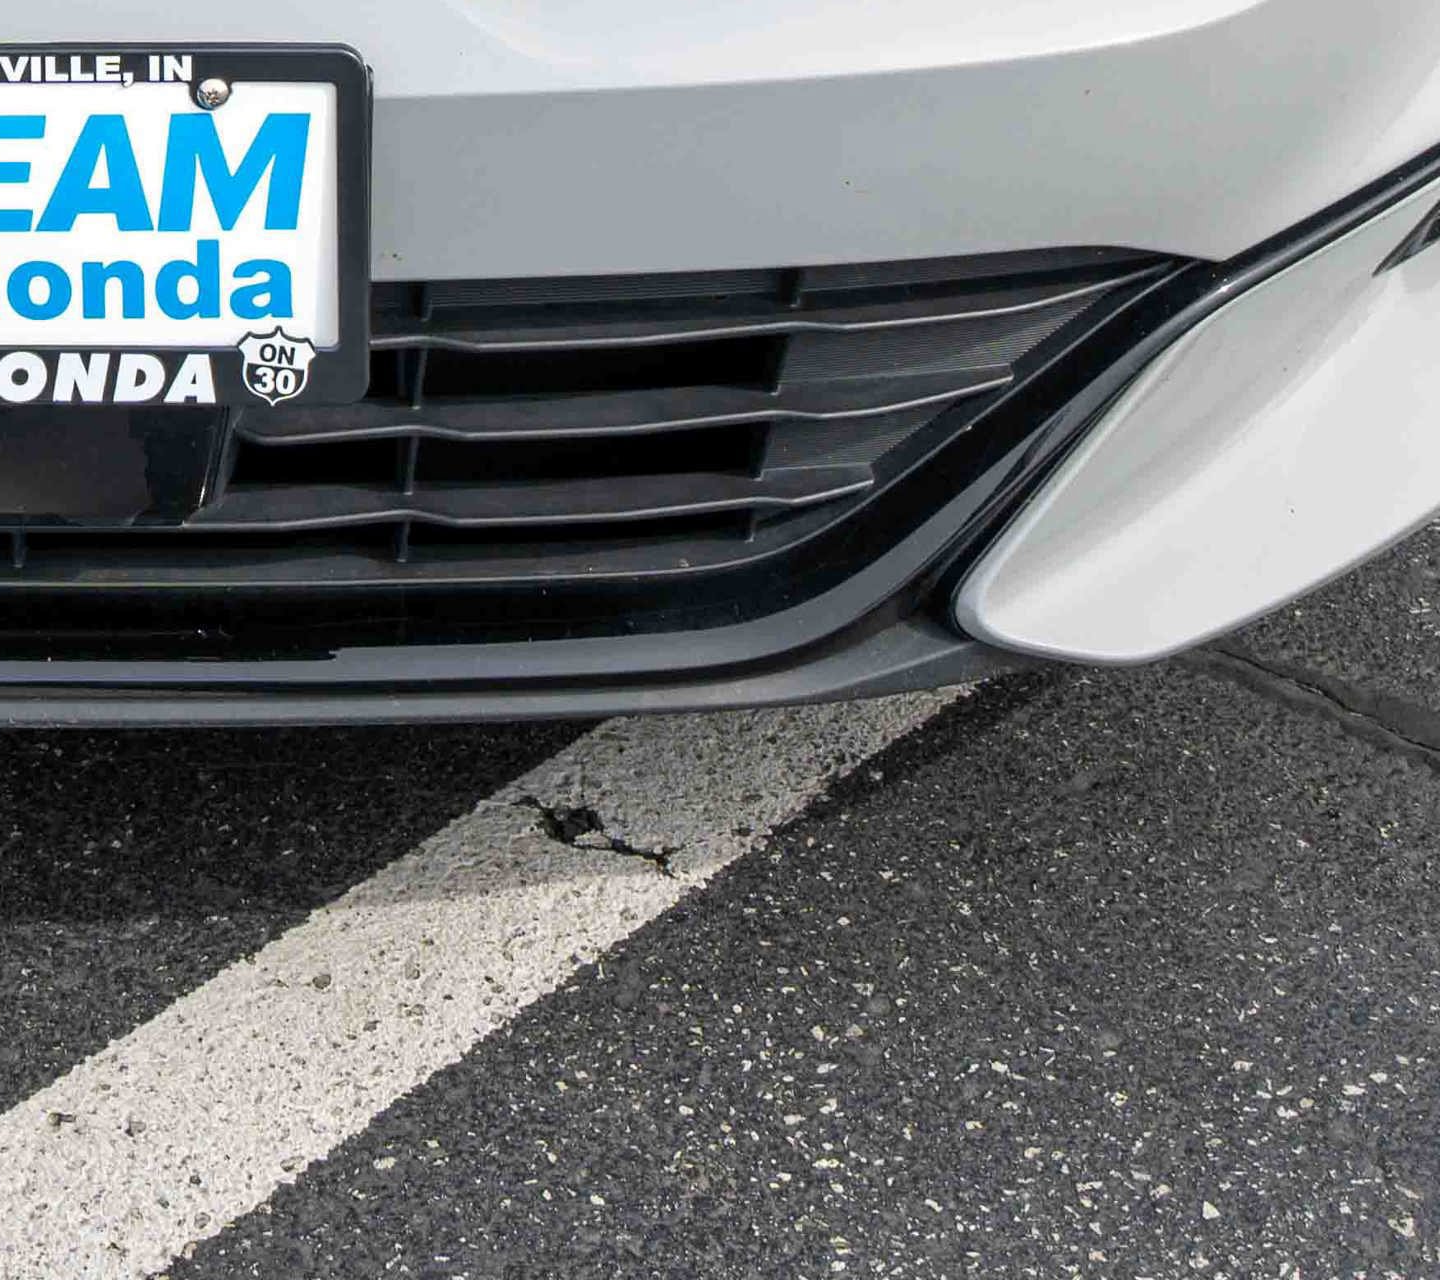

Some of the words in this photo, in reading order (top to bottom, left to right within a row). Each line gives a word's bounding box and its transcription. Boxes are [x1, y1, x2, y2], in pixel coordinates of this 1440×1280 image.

[149, 55, 193, 82] IN
[259, 343, 296, 366] ON
[253, 366, 296, 395] 30
